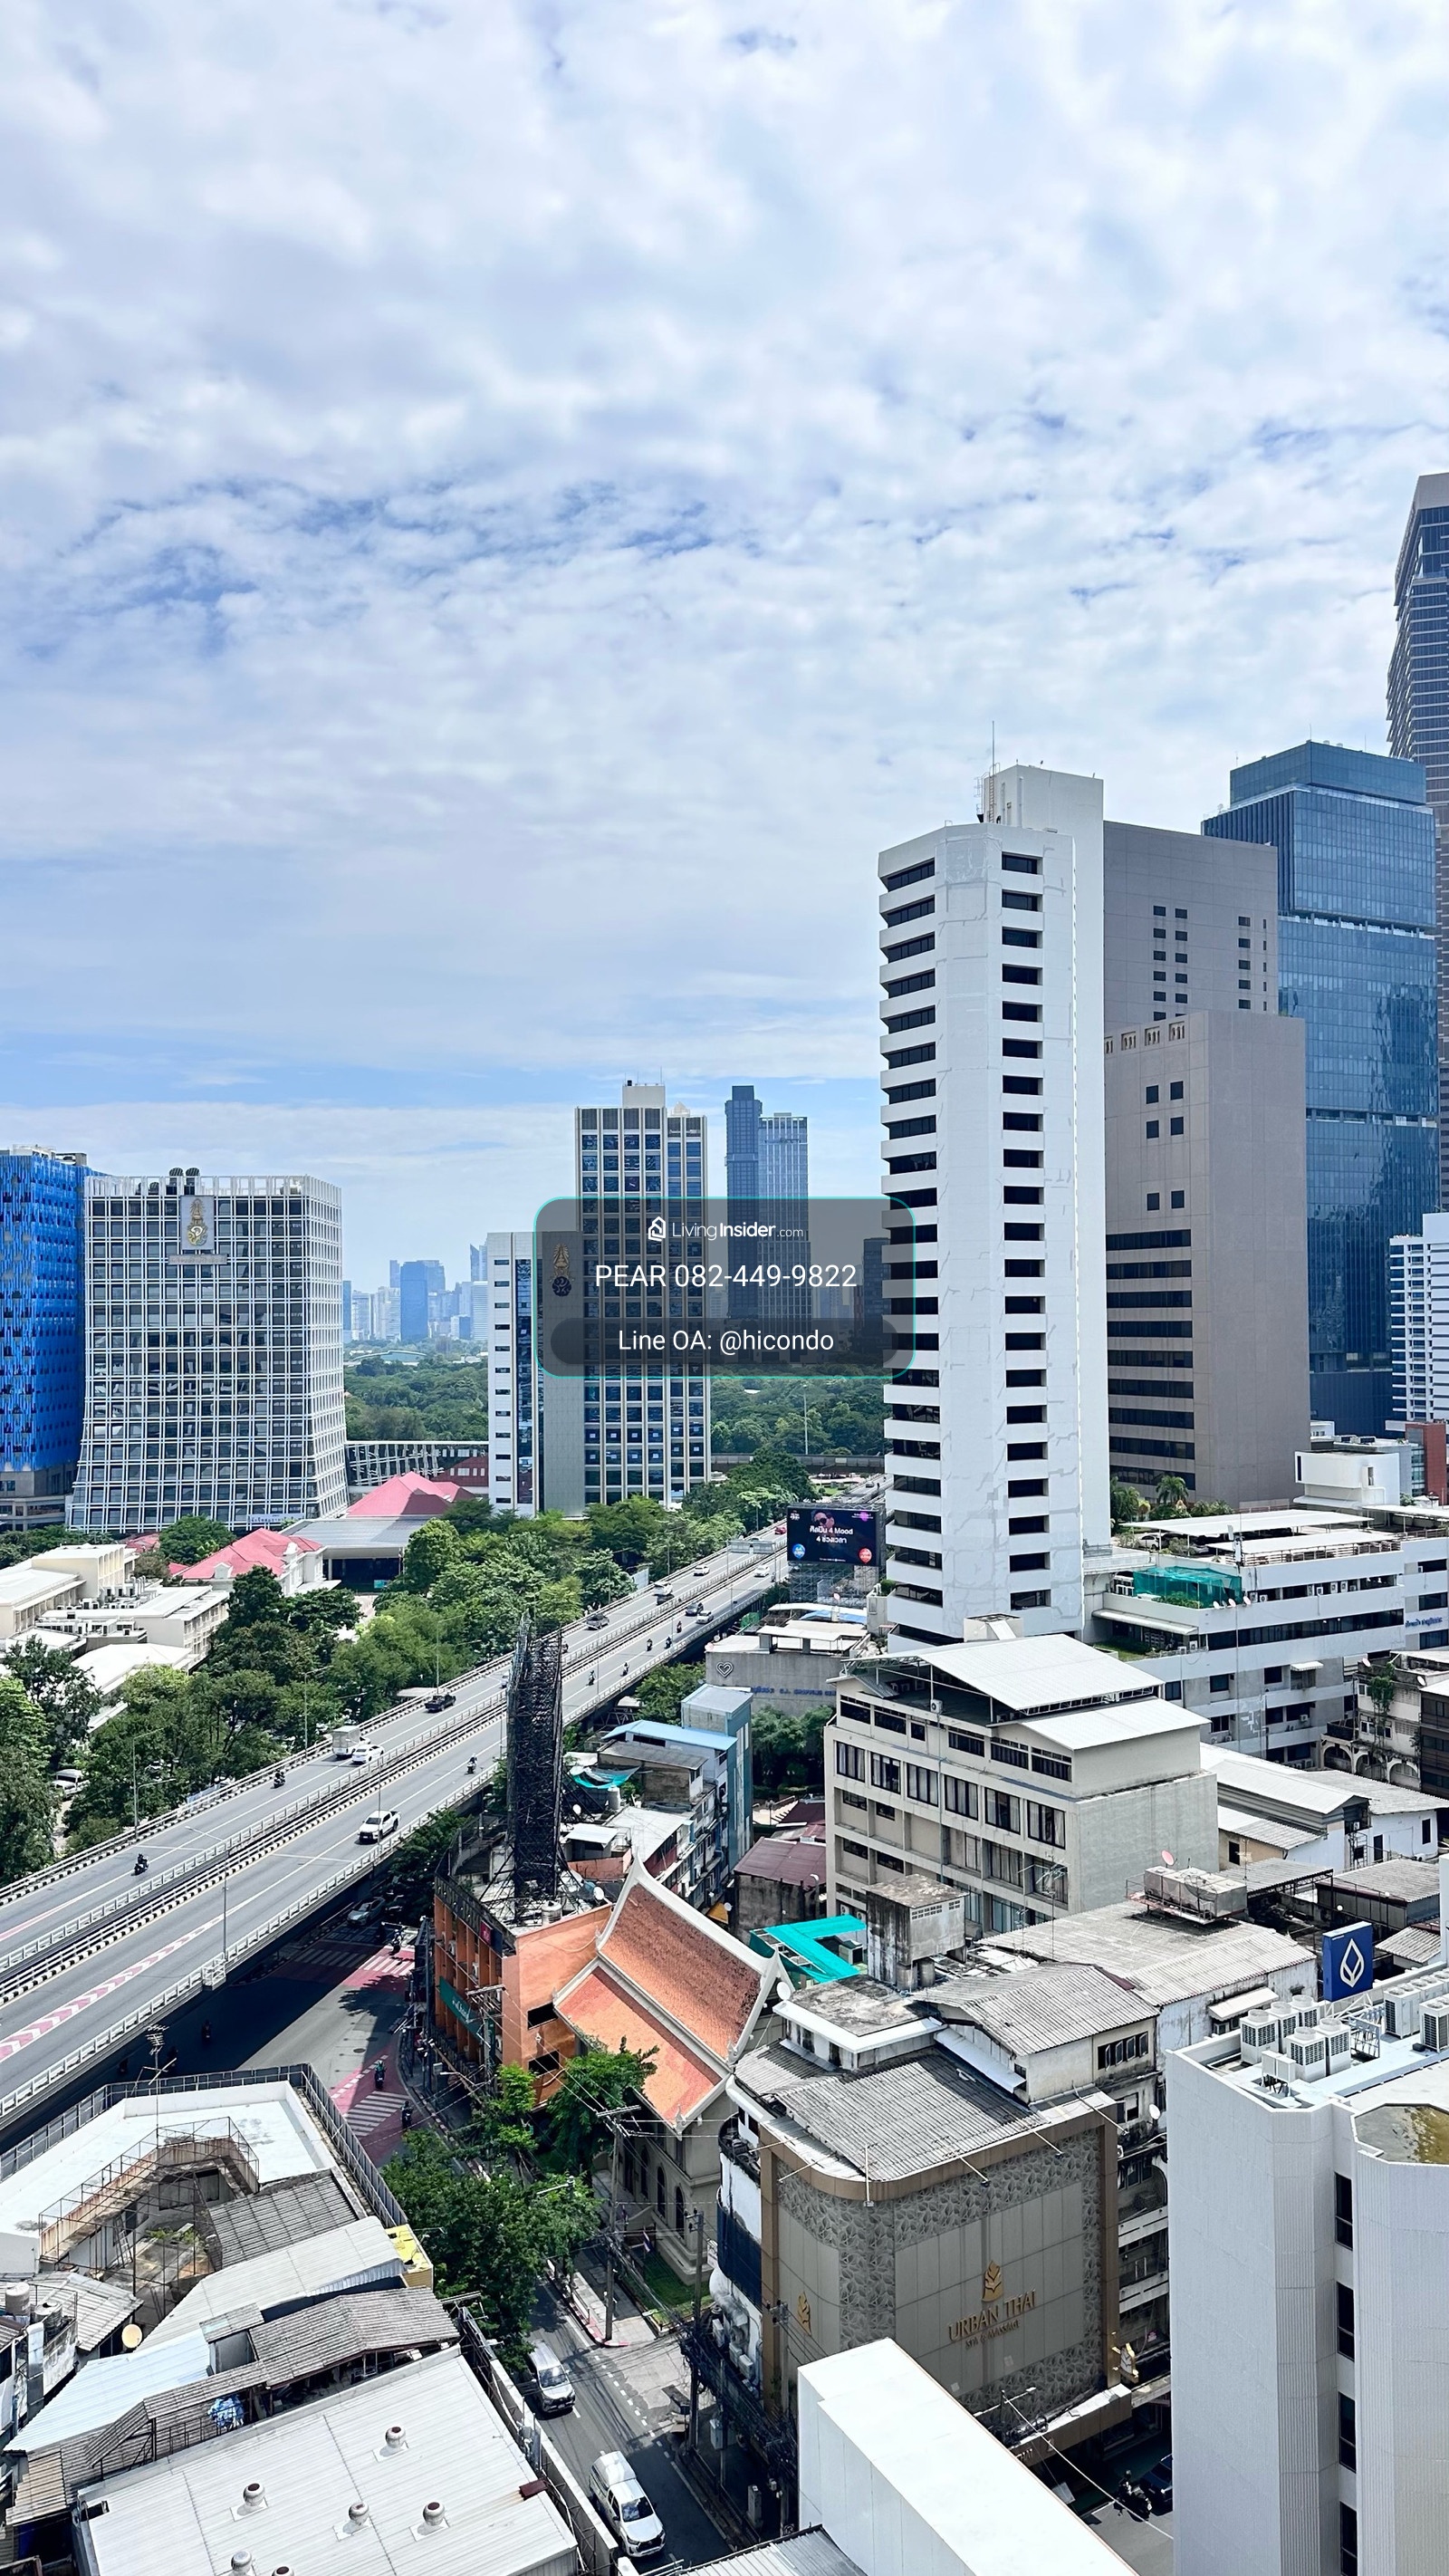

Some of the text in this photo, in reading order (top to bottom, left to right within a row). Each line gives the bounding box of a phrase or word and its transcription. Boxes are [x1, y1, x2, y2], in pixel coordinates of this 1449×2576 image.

[834, 1527, 853, 1535] Mood
[947, 2288, 1036, 2343] URBAN THAI
[965, 2337, 978, 2350] SPA
[987, 2319, 1020, 2339] MASSAGE
